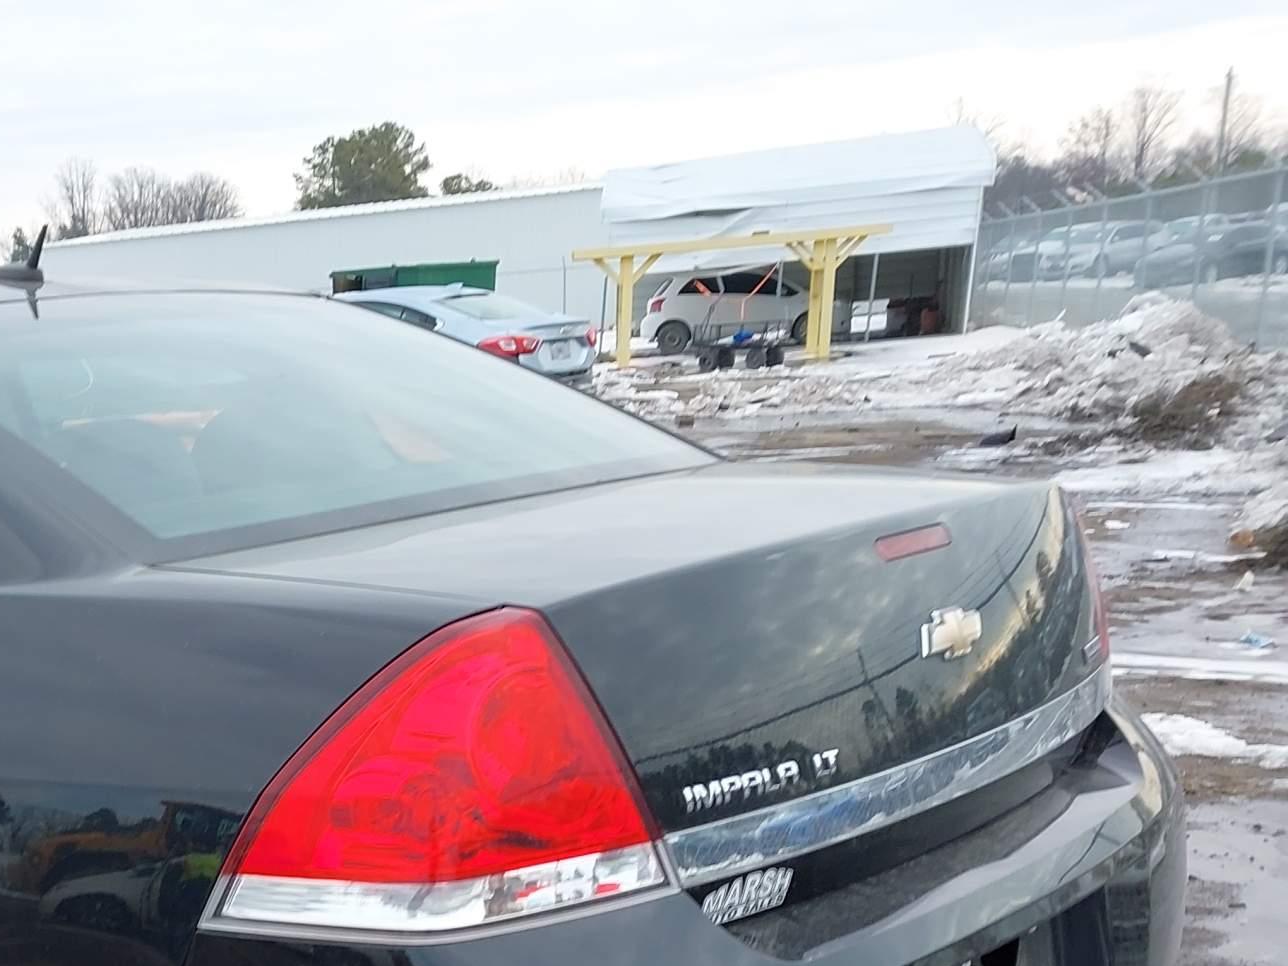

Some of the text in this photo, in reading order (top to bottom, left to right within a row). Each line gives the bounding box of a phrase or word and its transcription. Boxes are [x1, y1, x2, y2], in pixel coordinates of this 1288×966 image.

[682, 748, 839, 814] IMPALA LT
[702, 867, 794, 914] MARSH
